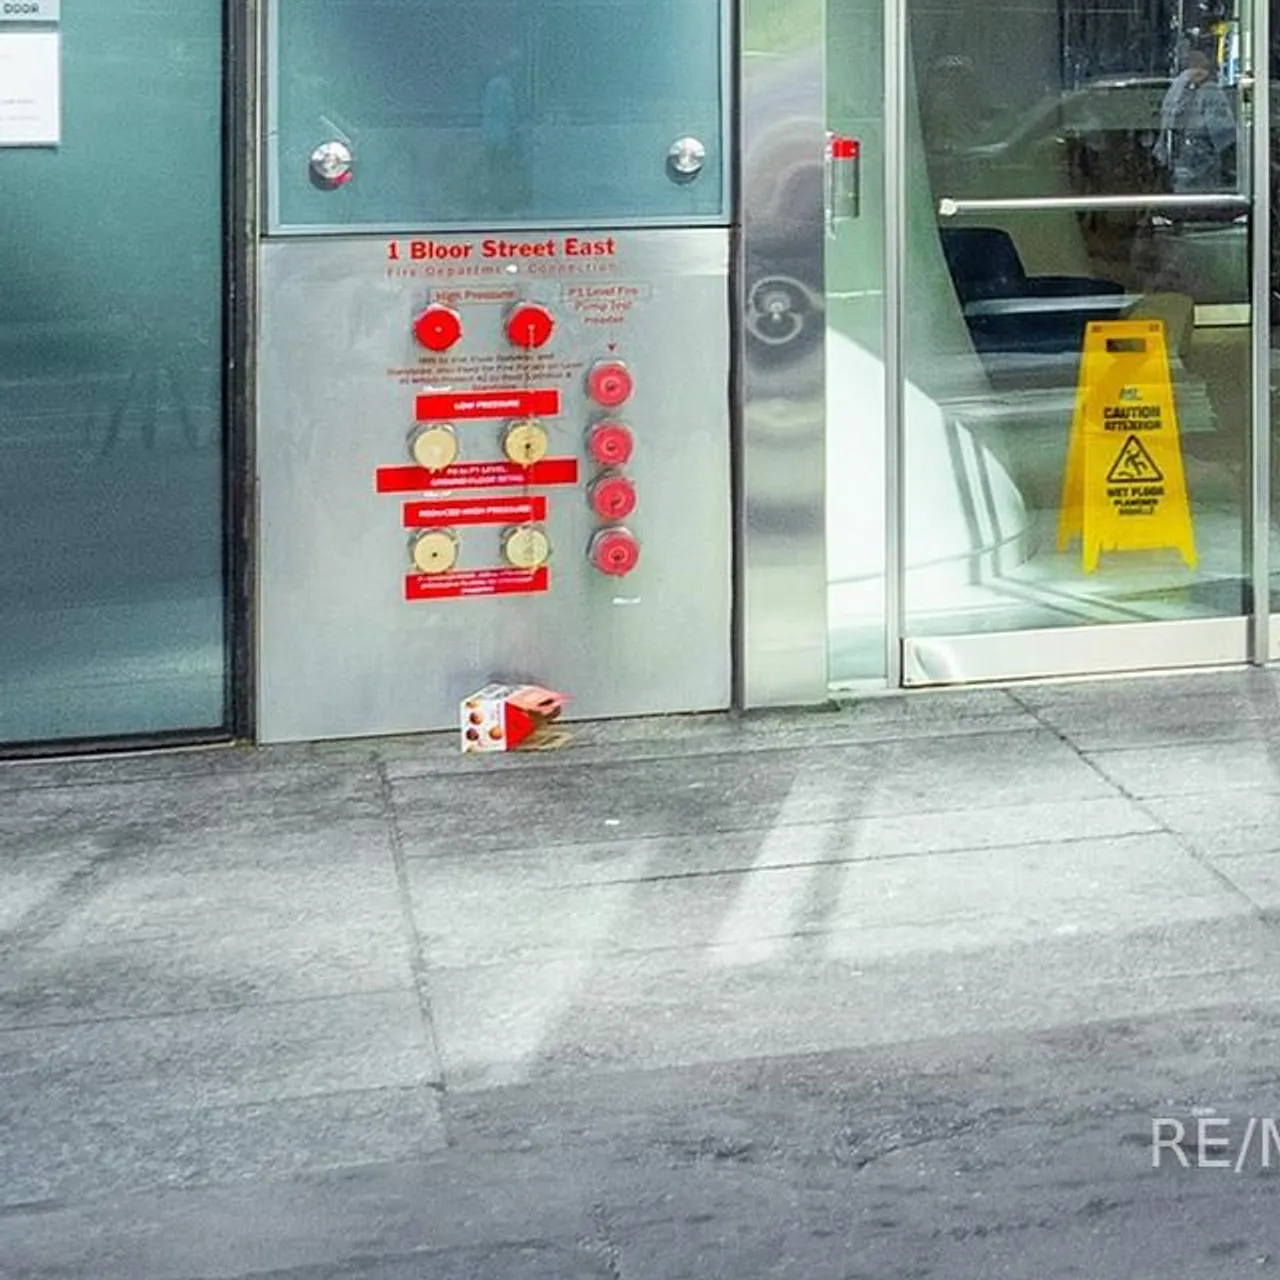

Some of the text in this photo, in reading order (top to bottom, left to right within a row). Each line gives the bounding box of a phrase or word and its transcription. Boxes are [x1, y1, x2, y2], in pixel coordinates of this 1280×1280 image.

[388, 237, 615, 259] 1 Bloor Street East
[1103, 406, 1161, 419] CAUTION
